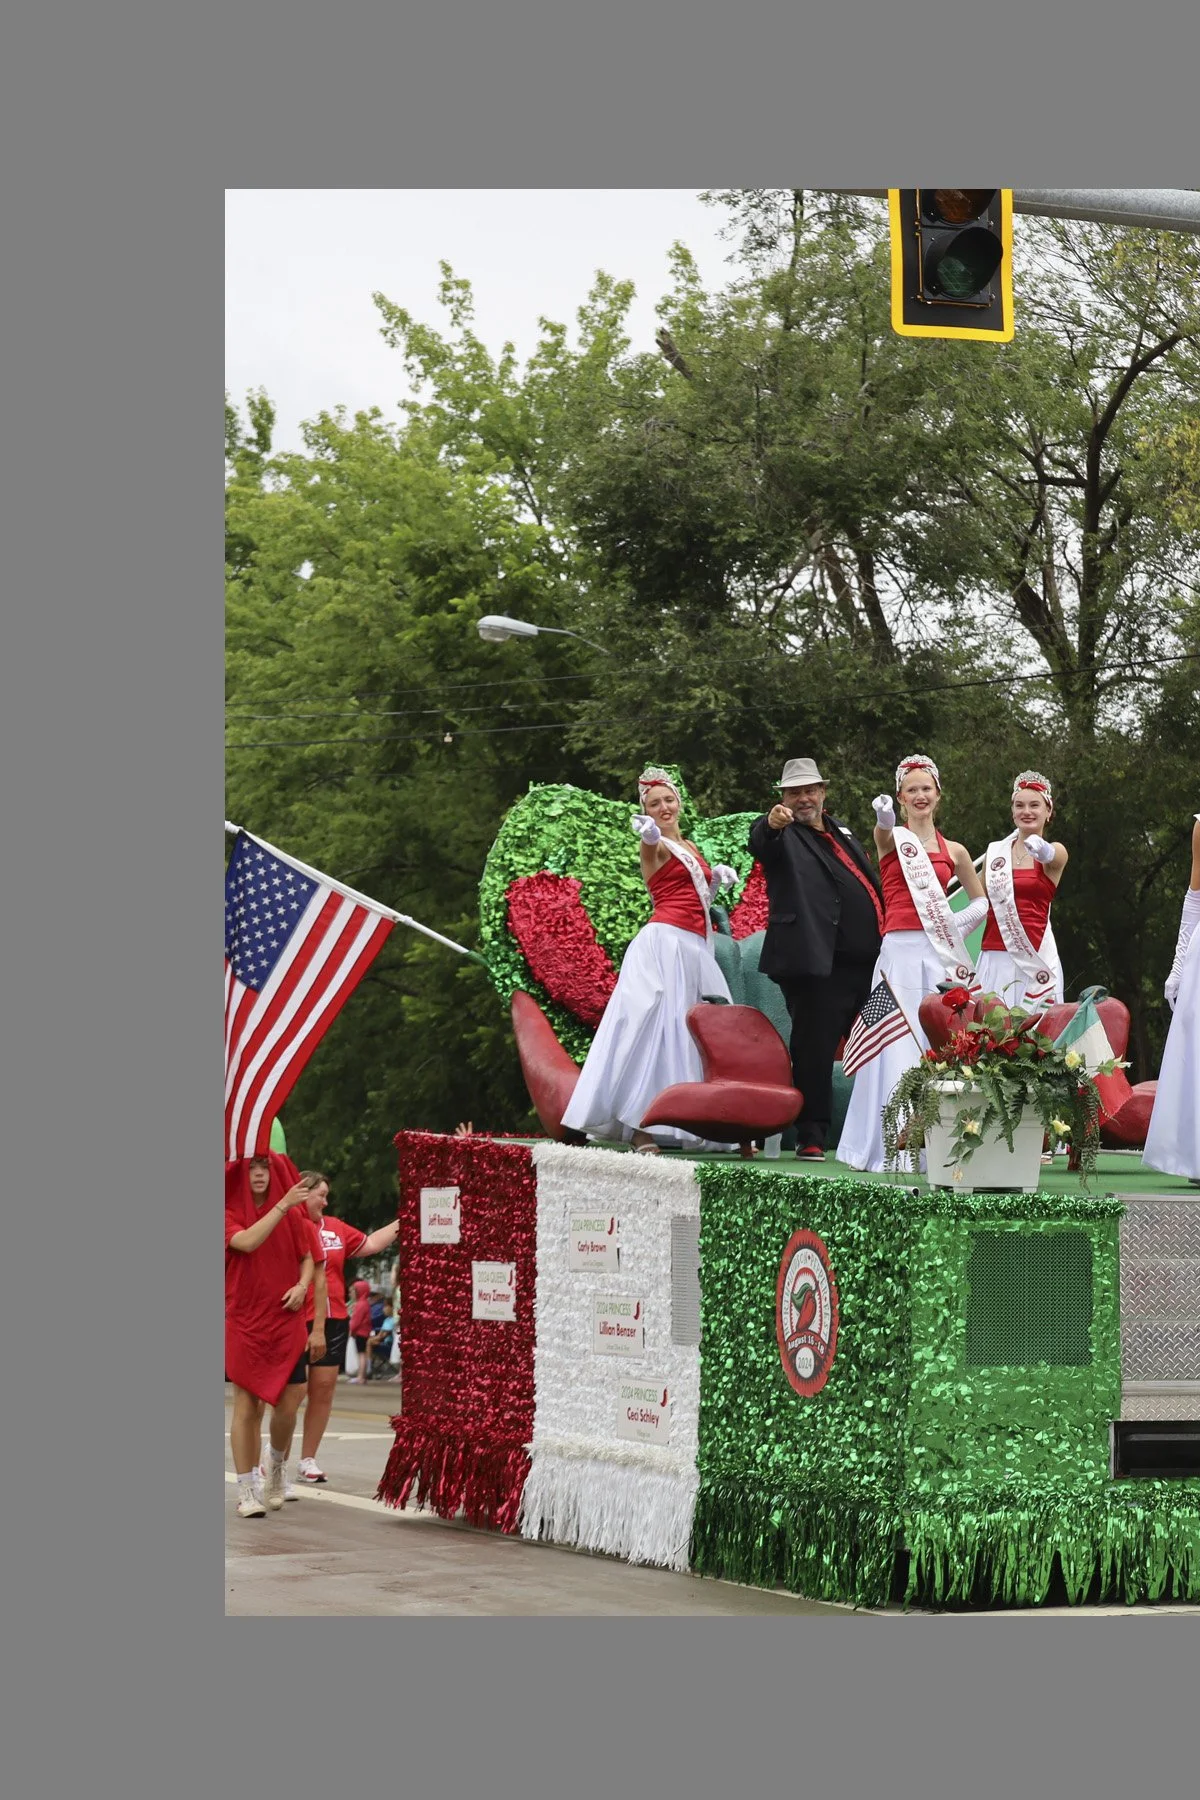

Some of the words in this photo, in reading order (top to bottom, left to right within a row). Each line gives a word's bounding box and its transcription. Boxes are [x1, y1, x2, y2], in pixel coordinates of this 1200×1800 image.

[428, 1213, 437, 1226] Jeff
[572, 1219, 583, 1231] 2024
[584, 1219, 605, 1231] PRINCESS
[578, 1240, 590, 1255] Carly
[591, 1241, 606, 1252] Brown
[478, 1271, 489, 1283] 2024
[490, 1271, 507, 1284] QUEEN
[478, 1289, 492, 1305] Macy
[493, 1289, 511, 1303] Zimmer
[596, 1301, 608, 1314] 2024
[609, 1302, 631, 1316] PRINCESS
[599, 1321, 615, 1335] Lillian
[616, 1323, 636, 1337] Benzer
[787, 1335, 806, 1351] August
[798, 1356, 812, 1369] 2024
[621, 1385, 633, 1399] 2024
[634, 1387, 658, 1403] PRINCESS
[627, 1407, 638, 1421] Ceci
[640, 1408, 659, 1428] Schley
